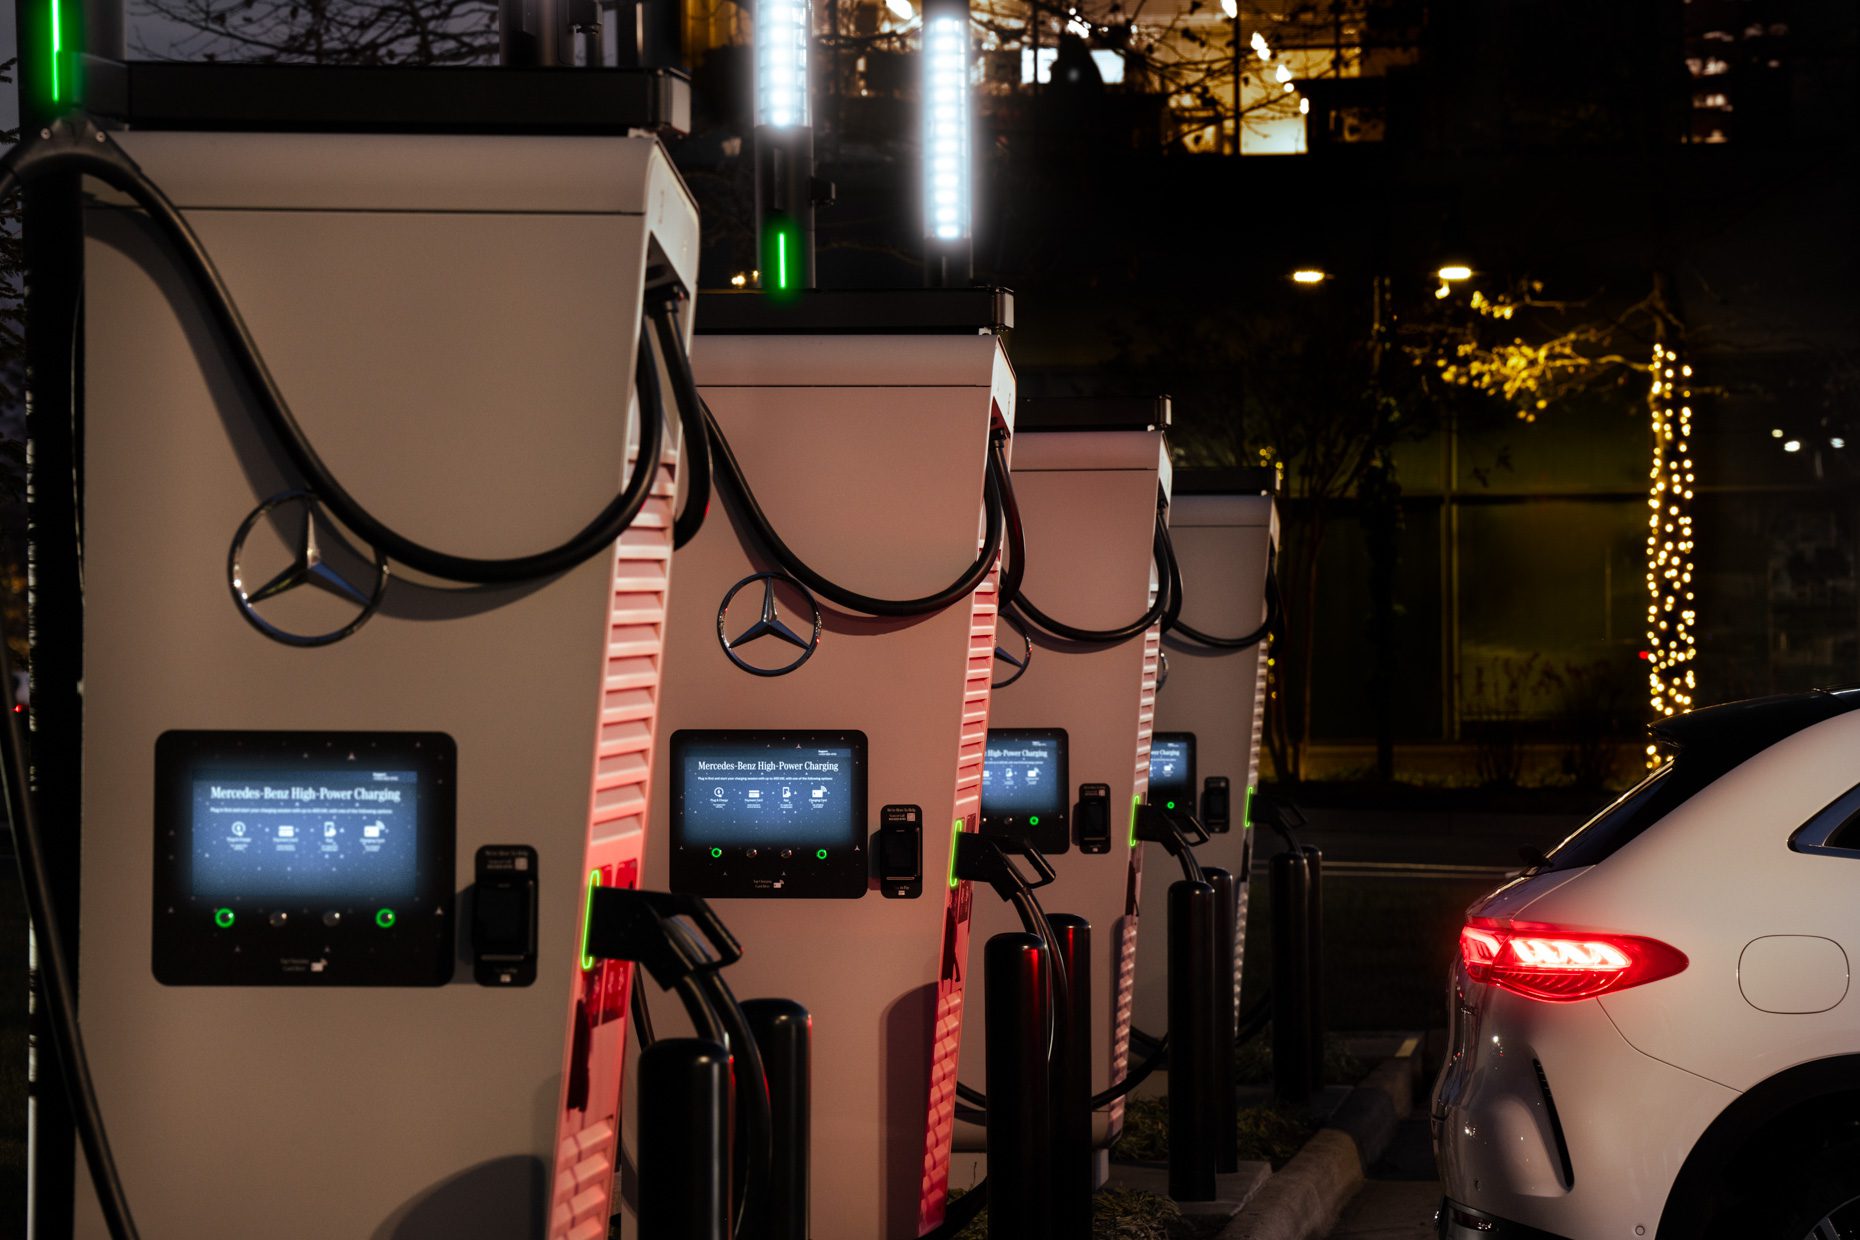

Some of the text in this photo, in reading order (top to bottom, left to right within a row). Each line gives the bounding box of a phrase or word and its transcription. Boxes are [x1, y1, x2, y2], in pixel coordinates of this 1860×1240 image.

[988, 749, 1048, 758] High-Power Charging
[698, 761, 839, 772] Mercedes-Benz High-Power Charging
[210, 786, 401, 802] Mercedes-Benz High-Power Charging
